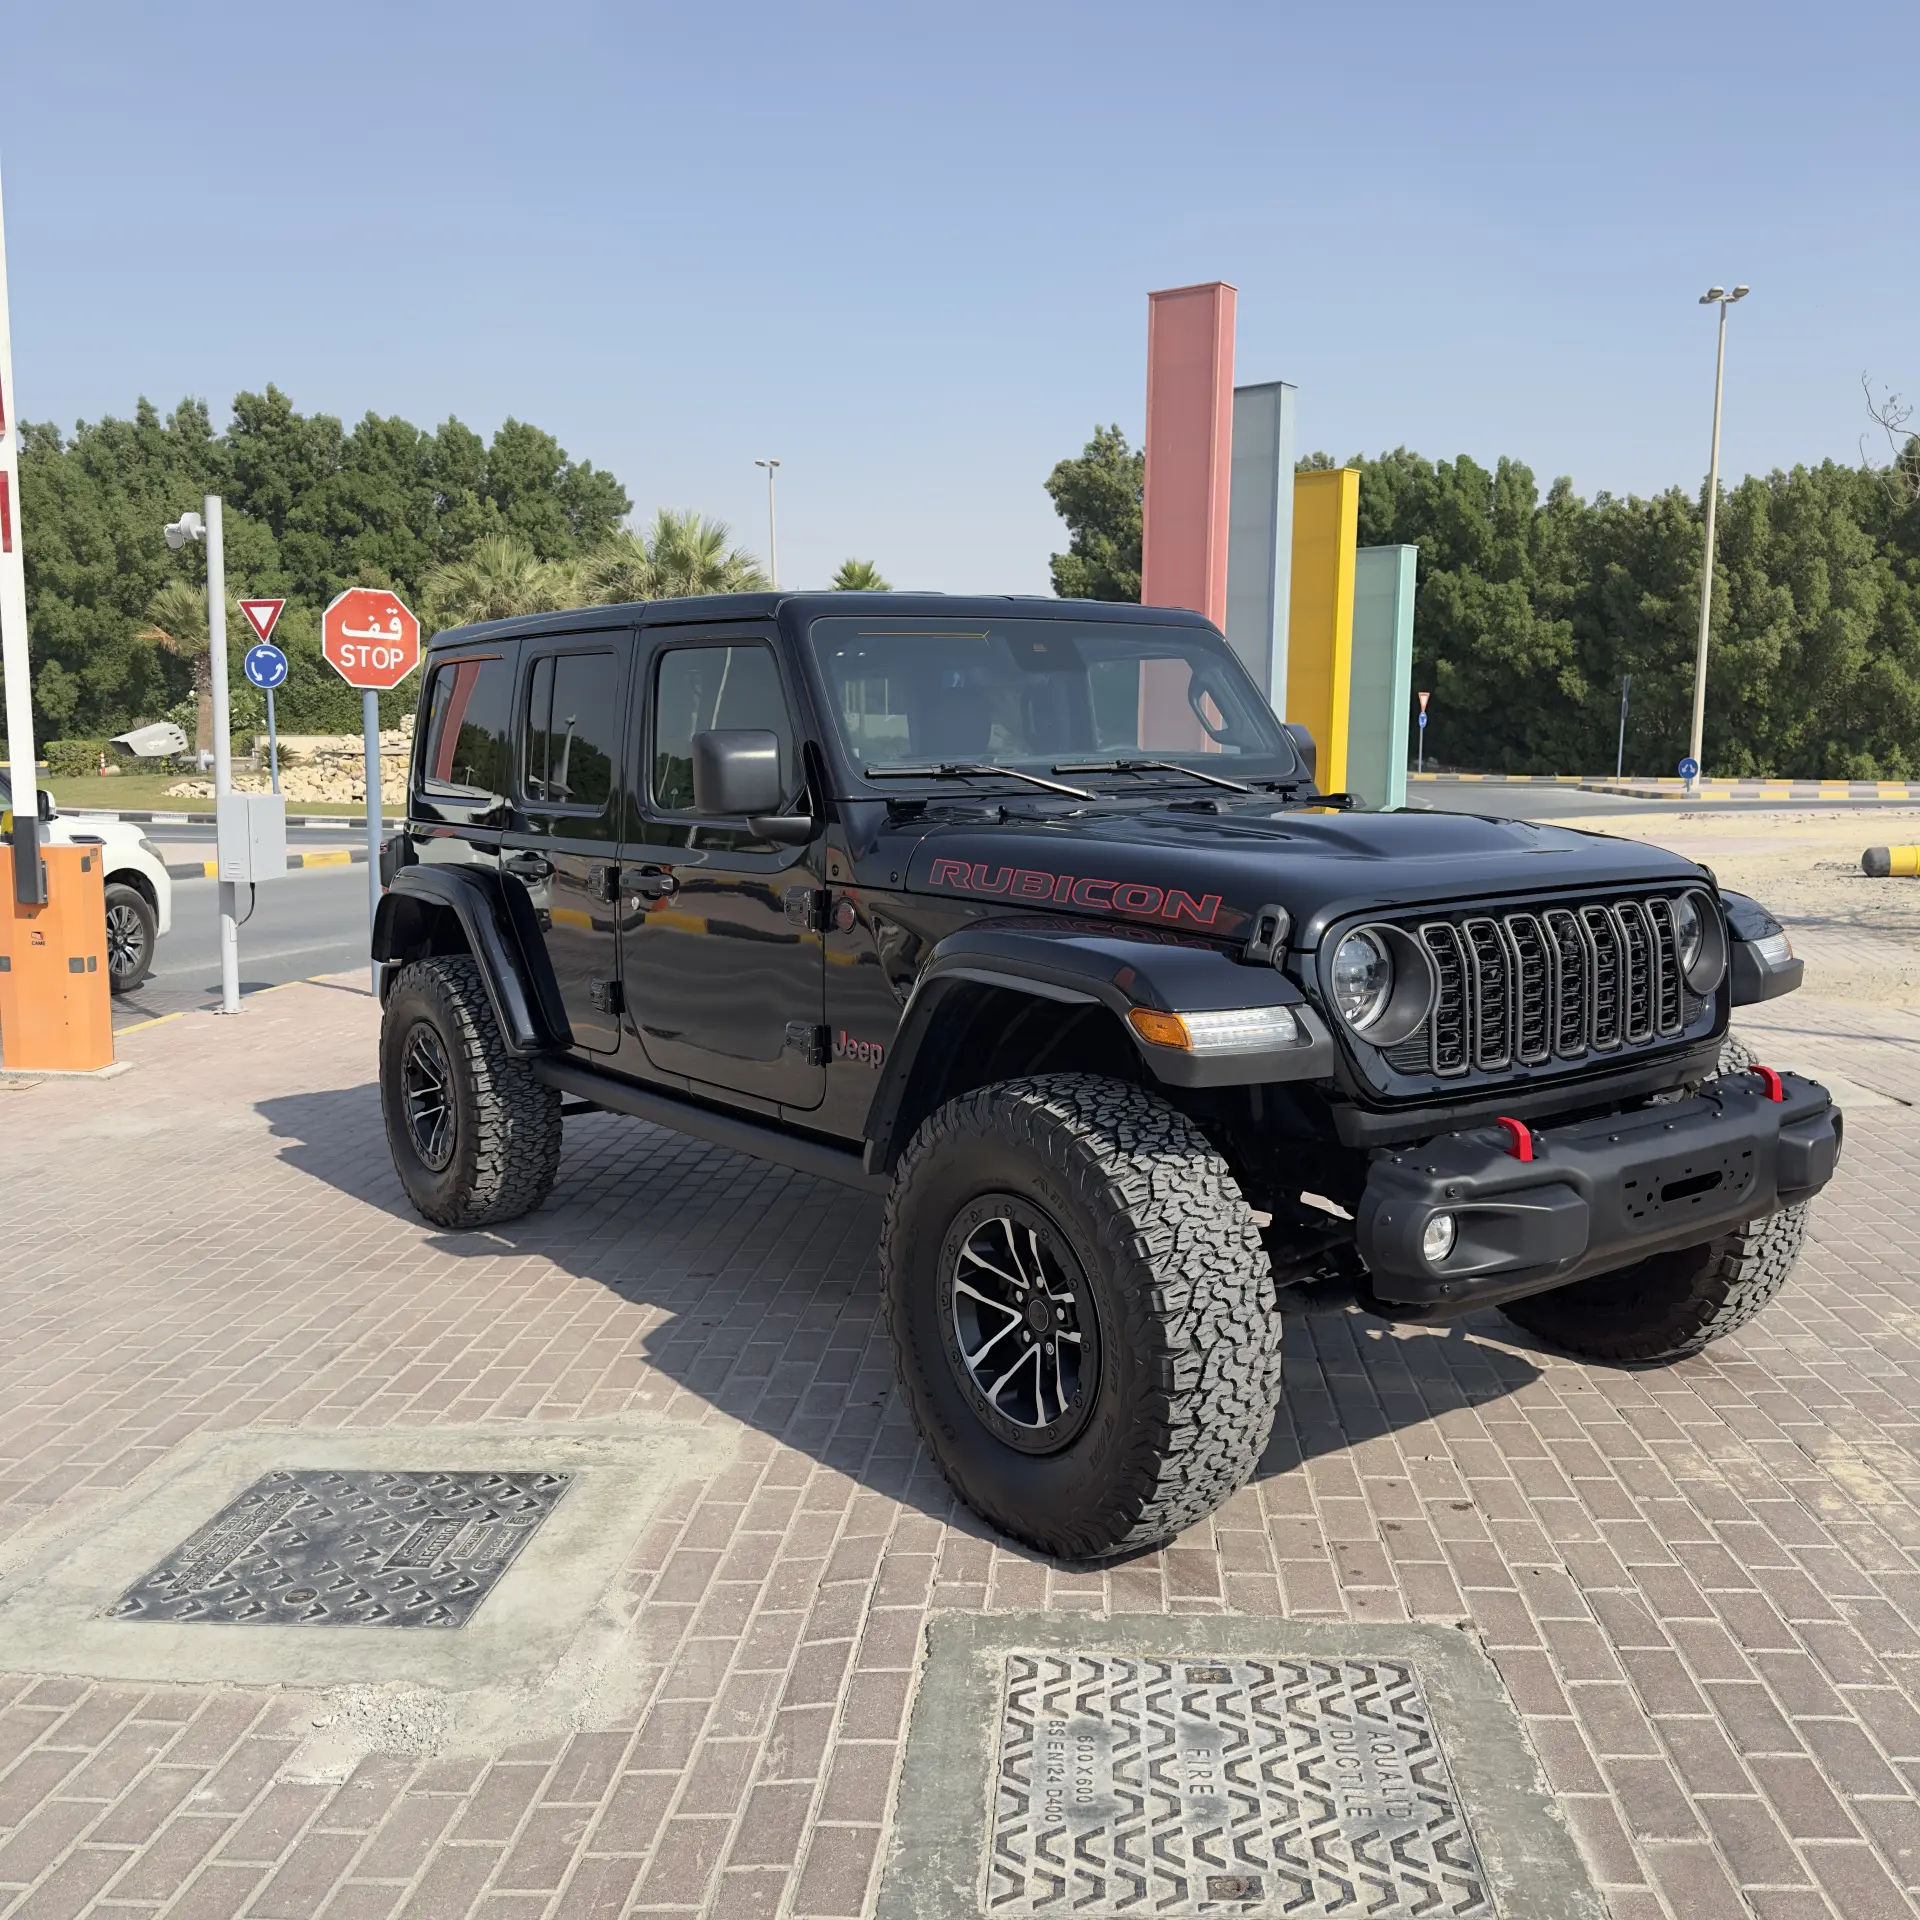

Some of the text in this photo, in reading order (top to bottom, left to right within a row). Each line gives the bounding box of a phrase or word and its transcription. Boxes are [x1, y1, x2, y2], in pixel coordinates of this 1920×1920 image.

[341, 608, 402, 640] قف
[340, 644, 404, 669] STOP
[929, 858, 1222, 924] RUBICON
[832, 1031, 884, 1069] Jeep
[411, 1520, 466, 1566] ELECTRICAL
[1048, 1719, 1067, 1737] BS
[1185, 1748, 1214, 1796] FIRE
[1330, 1730, 1372, 1817] DUCTILE
[1367, 1731, 1413, 1818] AQUALID
[1044, 1789, 1063, 1823] D400
